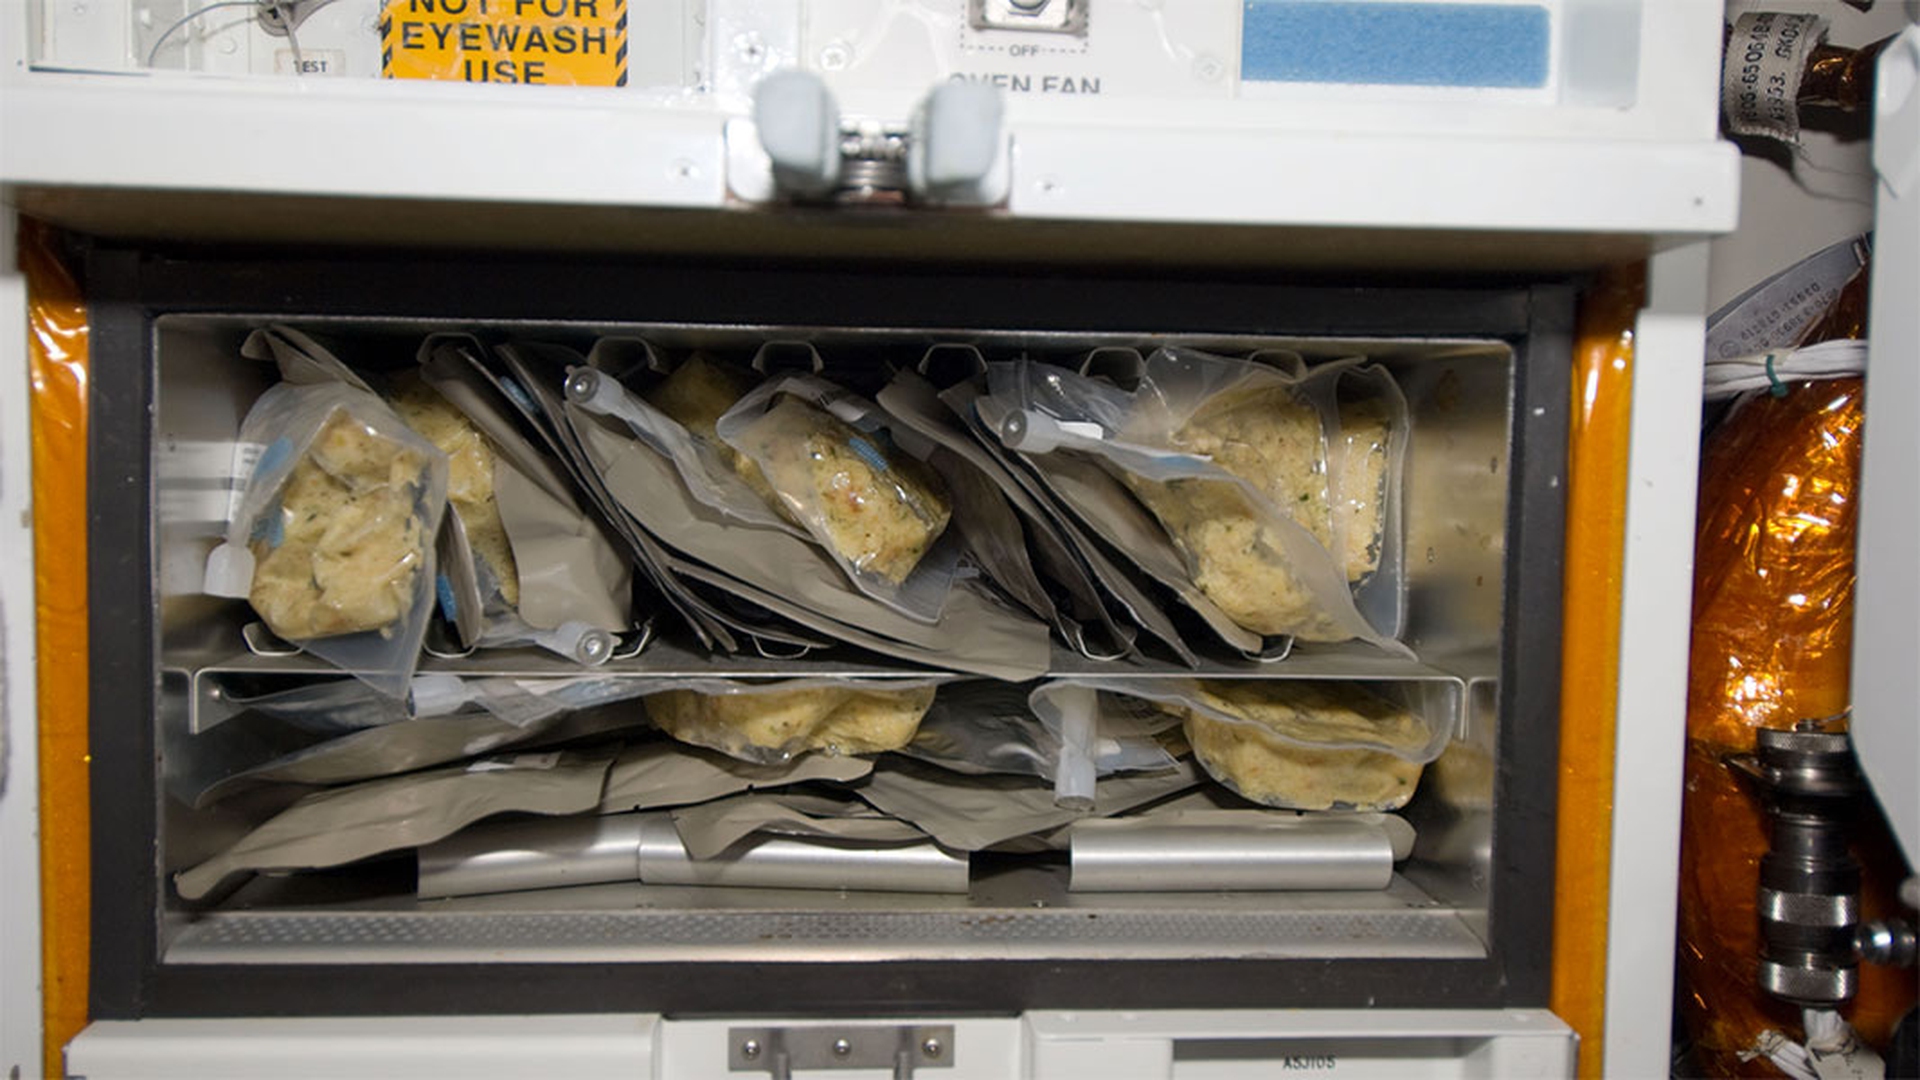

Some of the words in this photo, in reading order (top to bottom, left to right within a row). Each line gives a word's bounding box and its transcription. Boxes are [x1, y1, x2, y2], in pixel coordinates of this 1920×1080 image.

[515, 0, 598, 18] FOR
[402, 22, 607, 54] EYEWASH
[1009, 44, 1039, 57] OFF
[465, 60, 545, 84] USE
